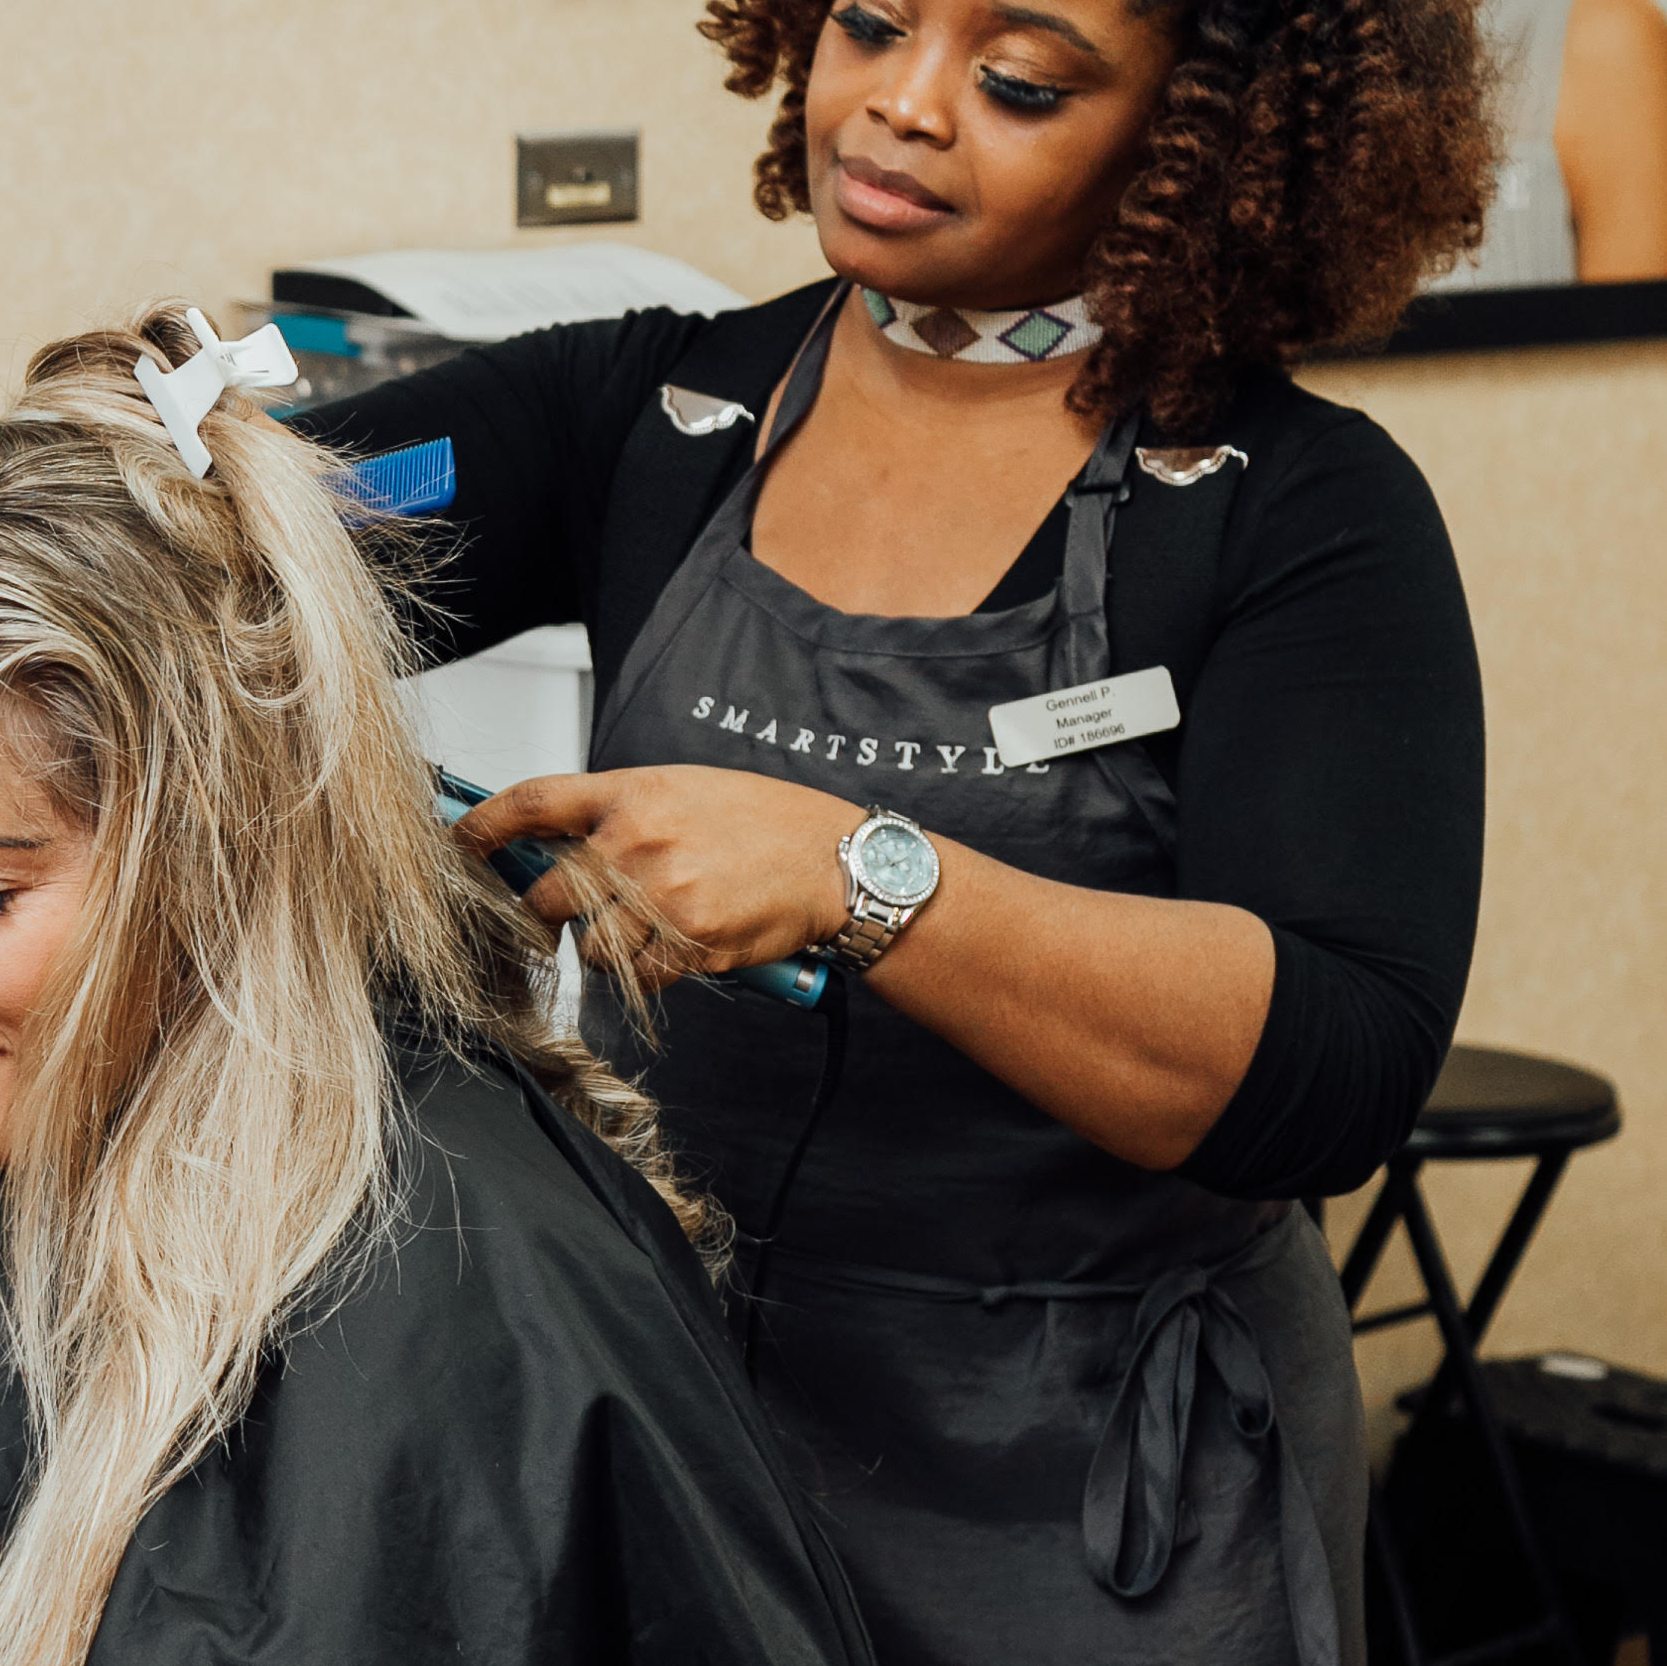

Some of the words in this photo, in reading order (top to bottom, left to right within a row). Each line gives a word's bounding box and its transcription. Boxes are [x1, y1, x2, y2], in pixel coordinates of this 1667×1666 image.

[1045, 689, 1098, 712] Gennell
[1056, 707, 1114, 730] Manager
[691, 695, 1050, 776] SMARTSTYL
[1053, 735, 1076, 750] ID#
